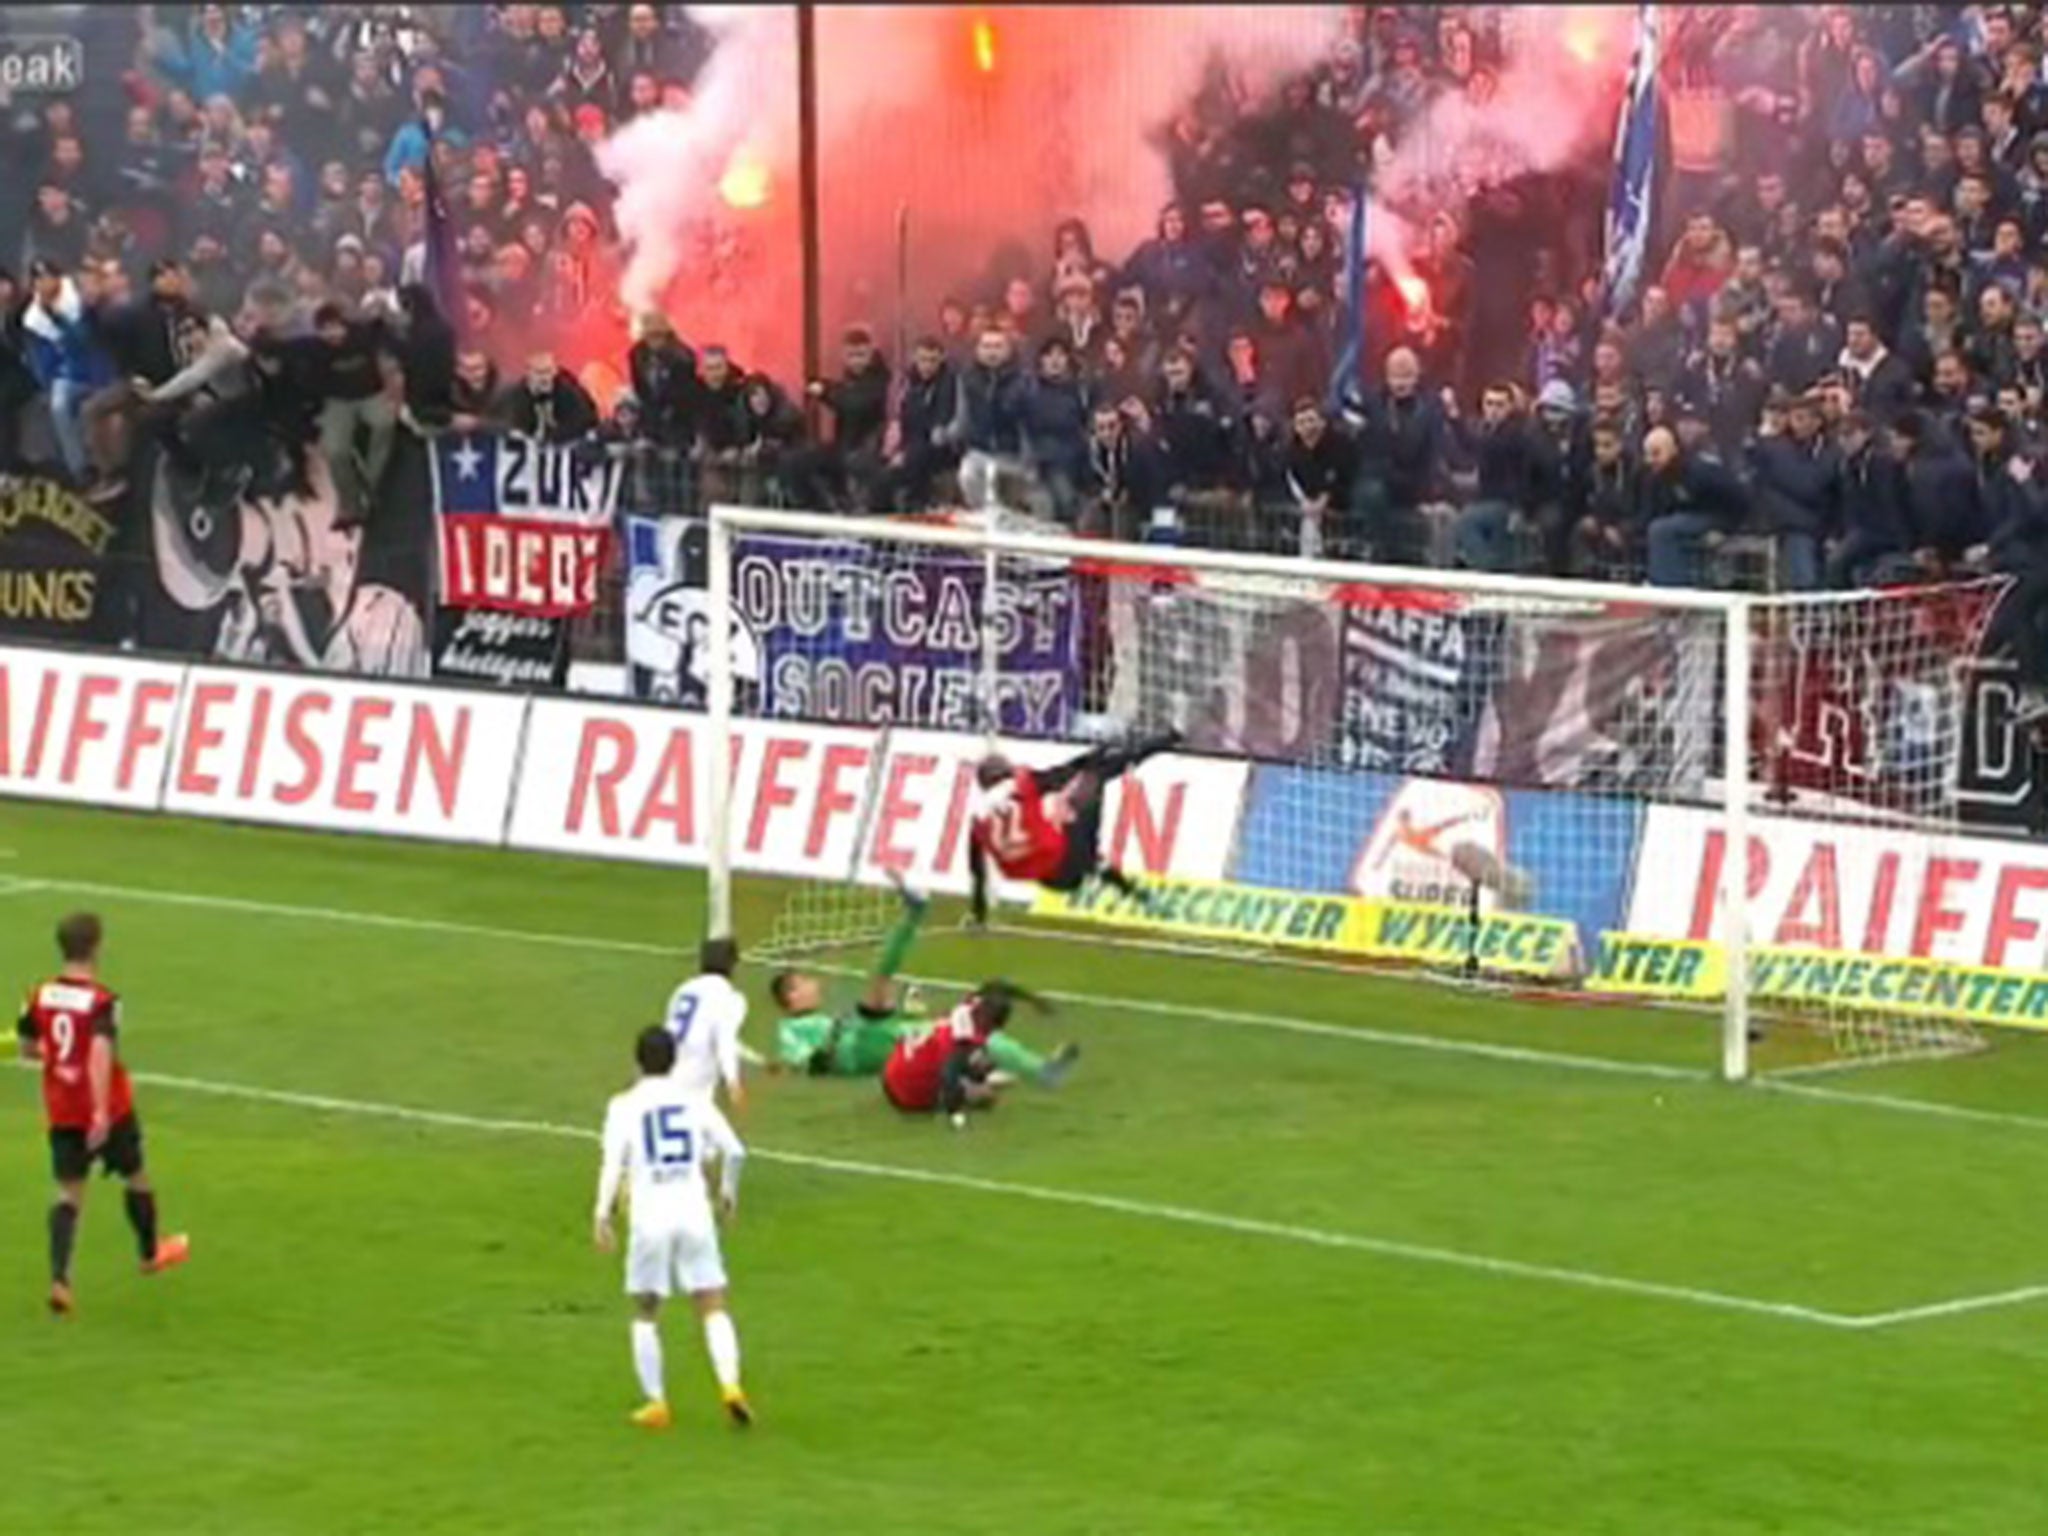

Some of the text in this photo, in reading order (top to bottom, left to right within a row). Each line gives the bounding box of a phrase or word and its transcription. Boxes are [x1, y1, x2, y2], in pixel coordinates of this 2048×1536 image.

[738, 555, 1068, 654] OUTCAST
[0, 664, 472, 820] IFFEISEN
[51, 1012, 75, 1063] 9
[641, 1105, 692, 1164] 15
